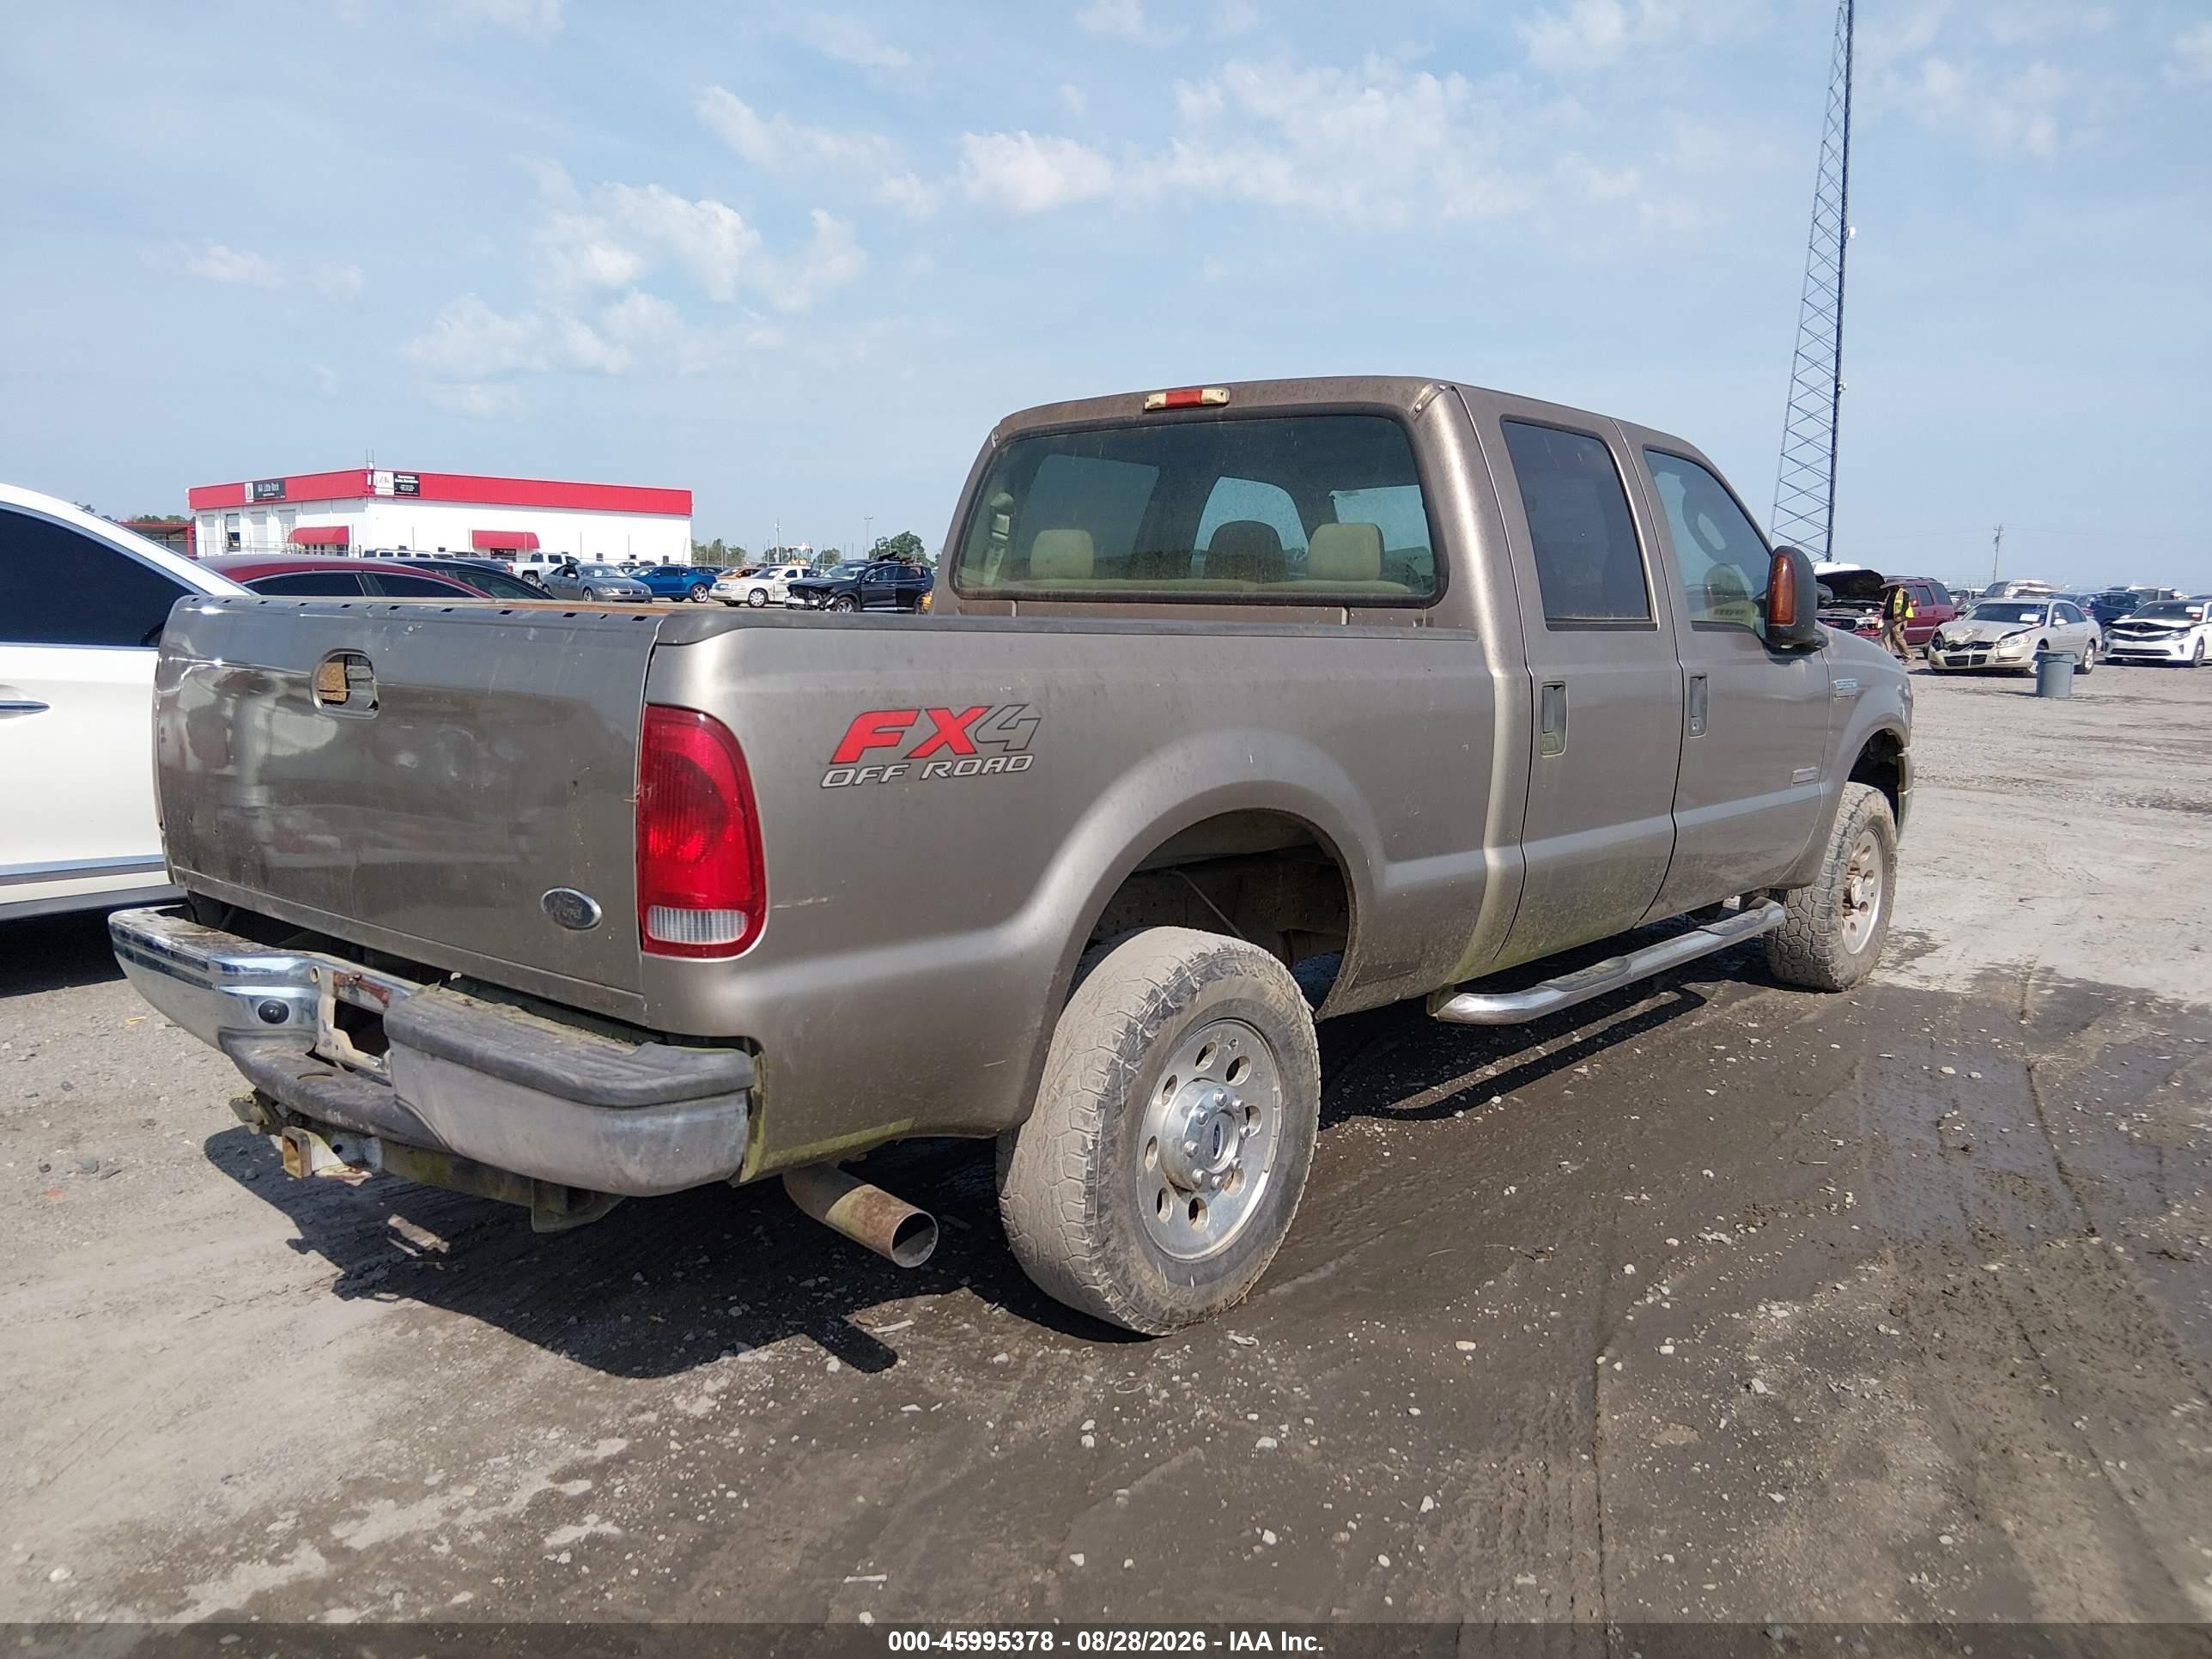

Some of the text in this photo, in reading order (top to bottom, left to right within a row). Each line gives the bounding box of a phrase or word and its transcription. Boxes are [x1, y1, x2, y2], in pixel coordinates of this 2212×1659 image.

[830, 702, 1042, 765] FX4
[820, 754, 1035, 789] OFF ROAD
